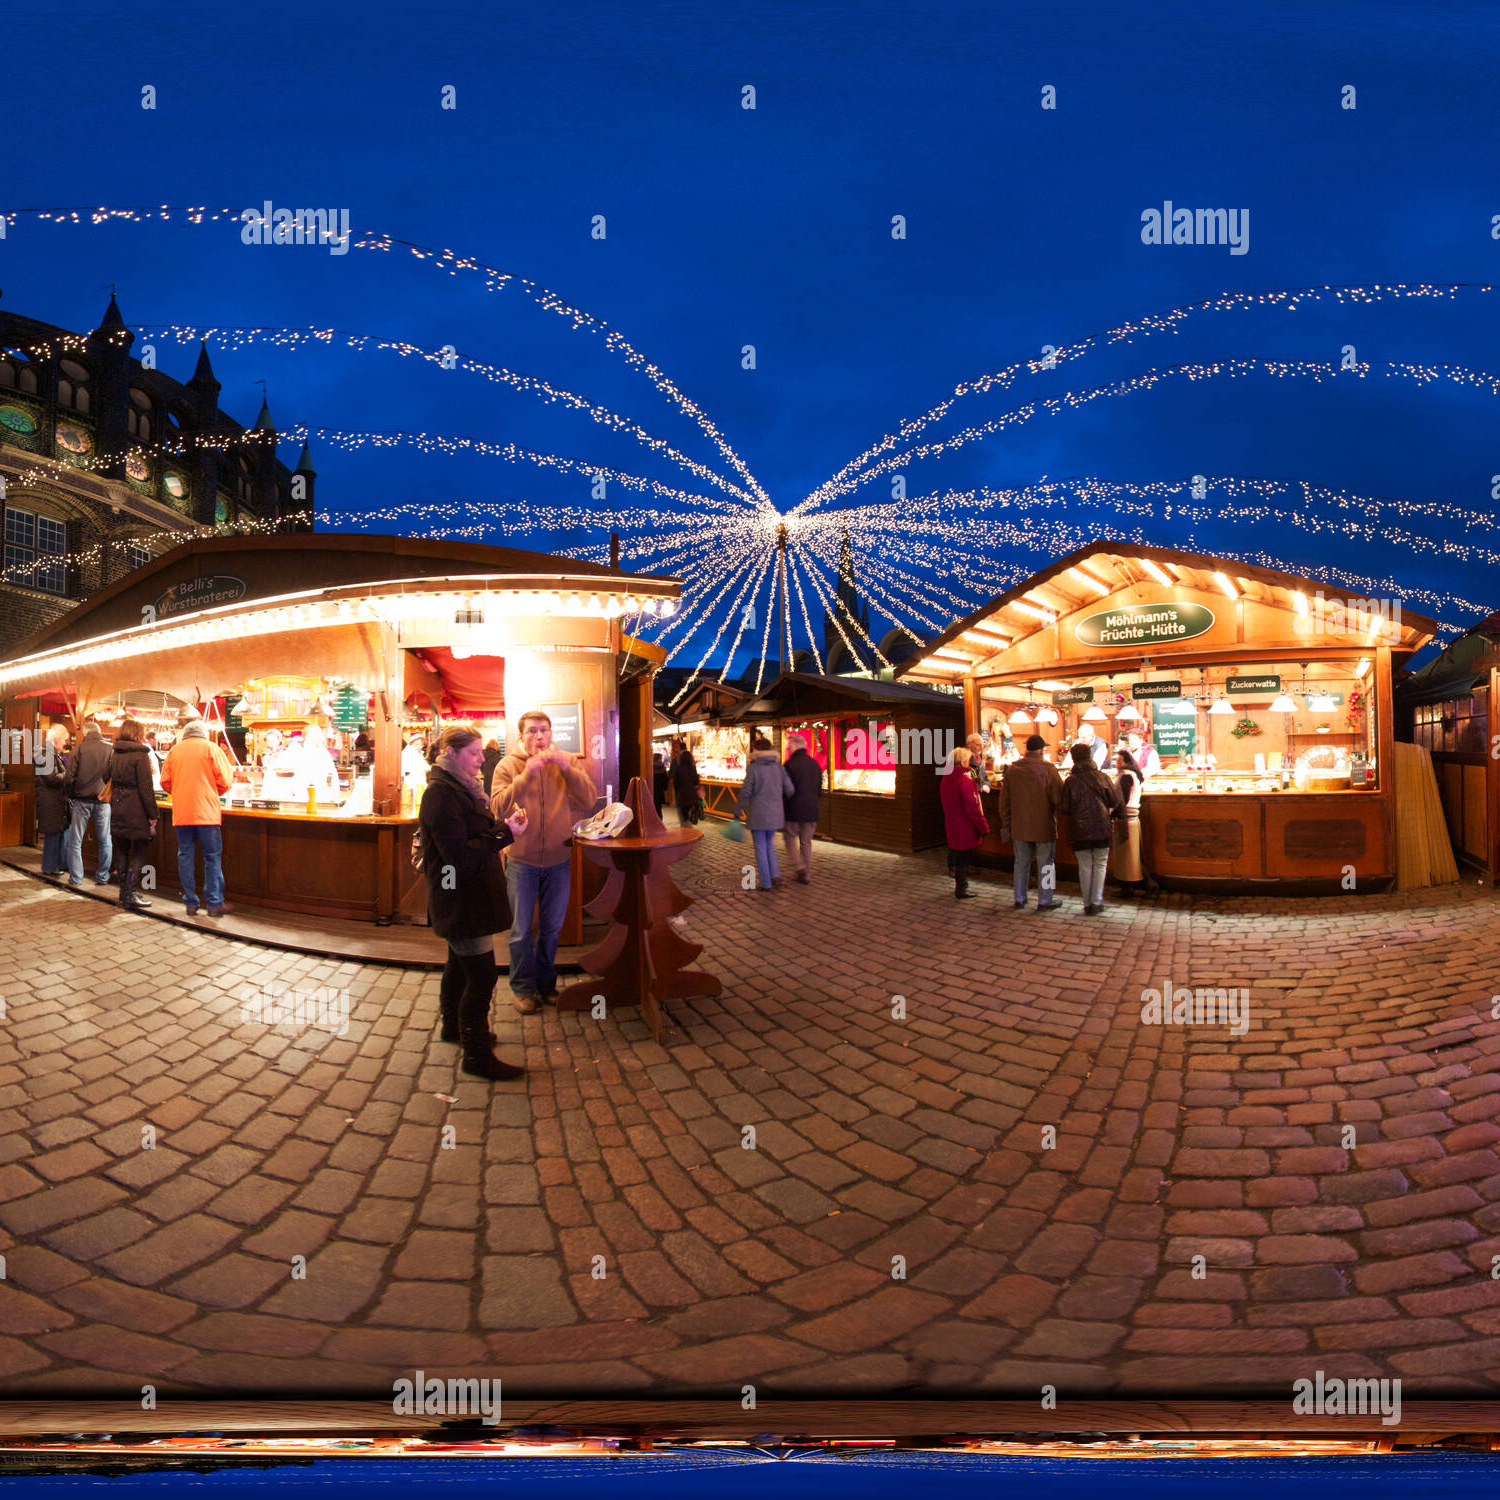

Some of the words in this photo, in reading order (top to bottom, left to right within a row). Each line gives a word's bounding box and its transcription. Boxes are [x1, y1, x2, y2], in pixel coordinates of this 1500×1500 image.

[180, 578, 213, 594] Belli's
[159, 586, 239, 615] Wurstbraterei
[1106, 610, 1178, 628] Möhlmann's
[1100, 623, 1186, 642] Früchte-Hütte
[1230, 680, 1276, 689] Zuckerwatte
